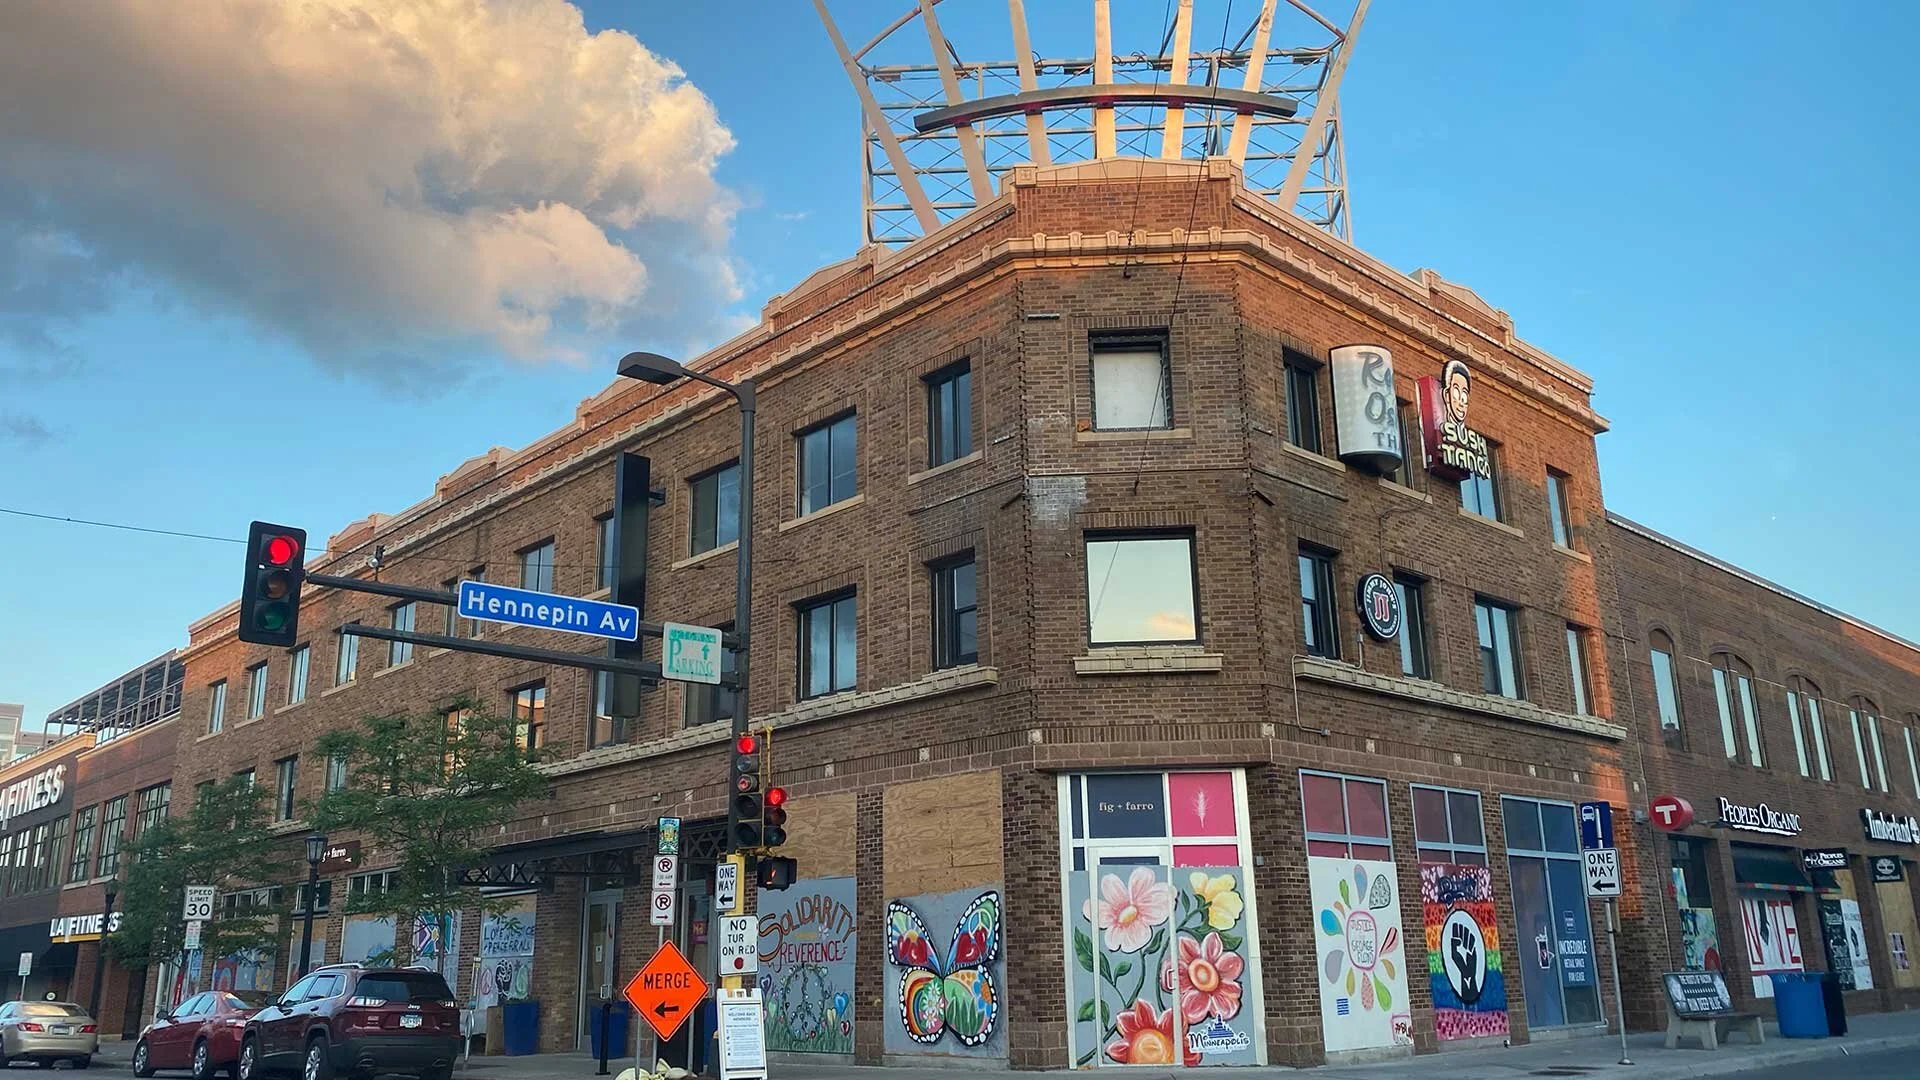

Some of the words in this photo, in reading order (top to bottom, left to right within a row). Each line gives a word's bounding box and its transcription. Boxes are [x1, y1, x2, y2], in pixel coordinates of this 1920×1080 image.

[1441, 443, 1491, 479] TANGO
[468, 590, 589, 626] Hennepin
[600, 611, 630, 632] Av
[6, 764, 67, 819] FITNESS
[1099, 802, 1114, 812] fig
[1125, 802, 1154, 811] farro
[1720, 797, 1760, 825] PEOPLES
[1760, 804, 1802, 831] ORGANIC
[1865, 808, 1912, 843] Timberland
[1588, 853, 1614, 864] ONE
[719, 867, 735, 879] ONE
[1588, 865, 1615, 878] WAY
[718, 880, 735, 891] WAY
[187, 903, 210, 916] 30
[50, 917, 64, 937] LA
[730, 919, 747, 931] NO
[759, 894, 856, 962] SOLIDARITY
[722, 946, 734, 956] ON
[738, 945, 755, 955] RED
[779, 941, 843, 964] REVERENCE
[1559, 940, 1587, 954] INCREDIBLE
[643, 972, 691, 989] MERGE
